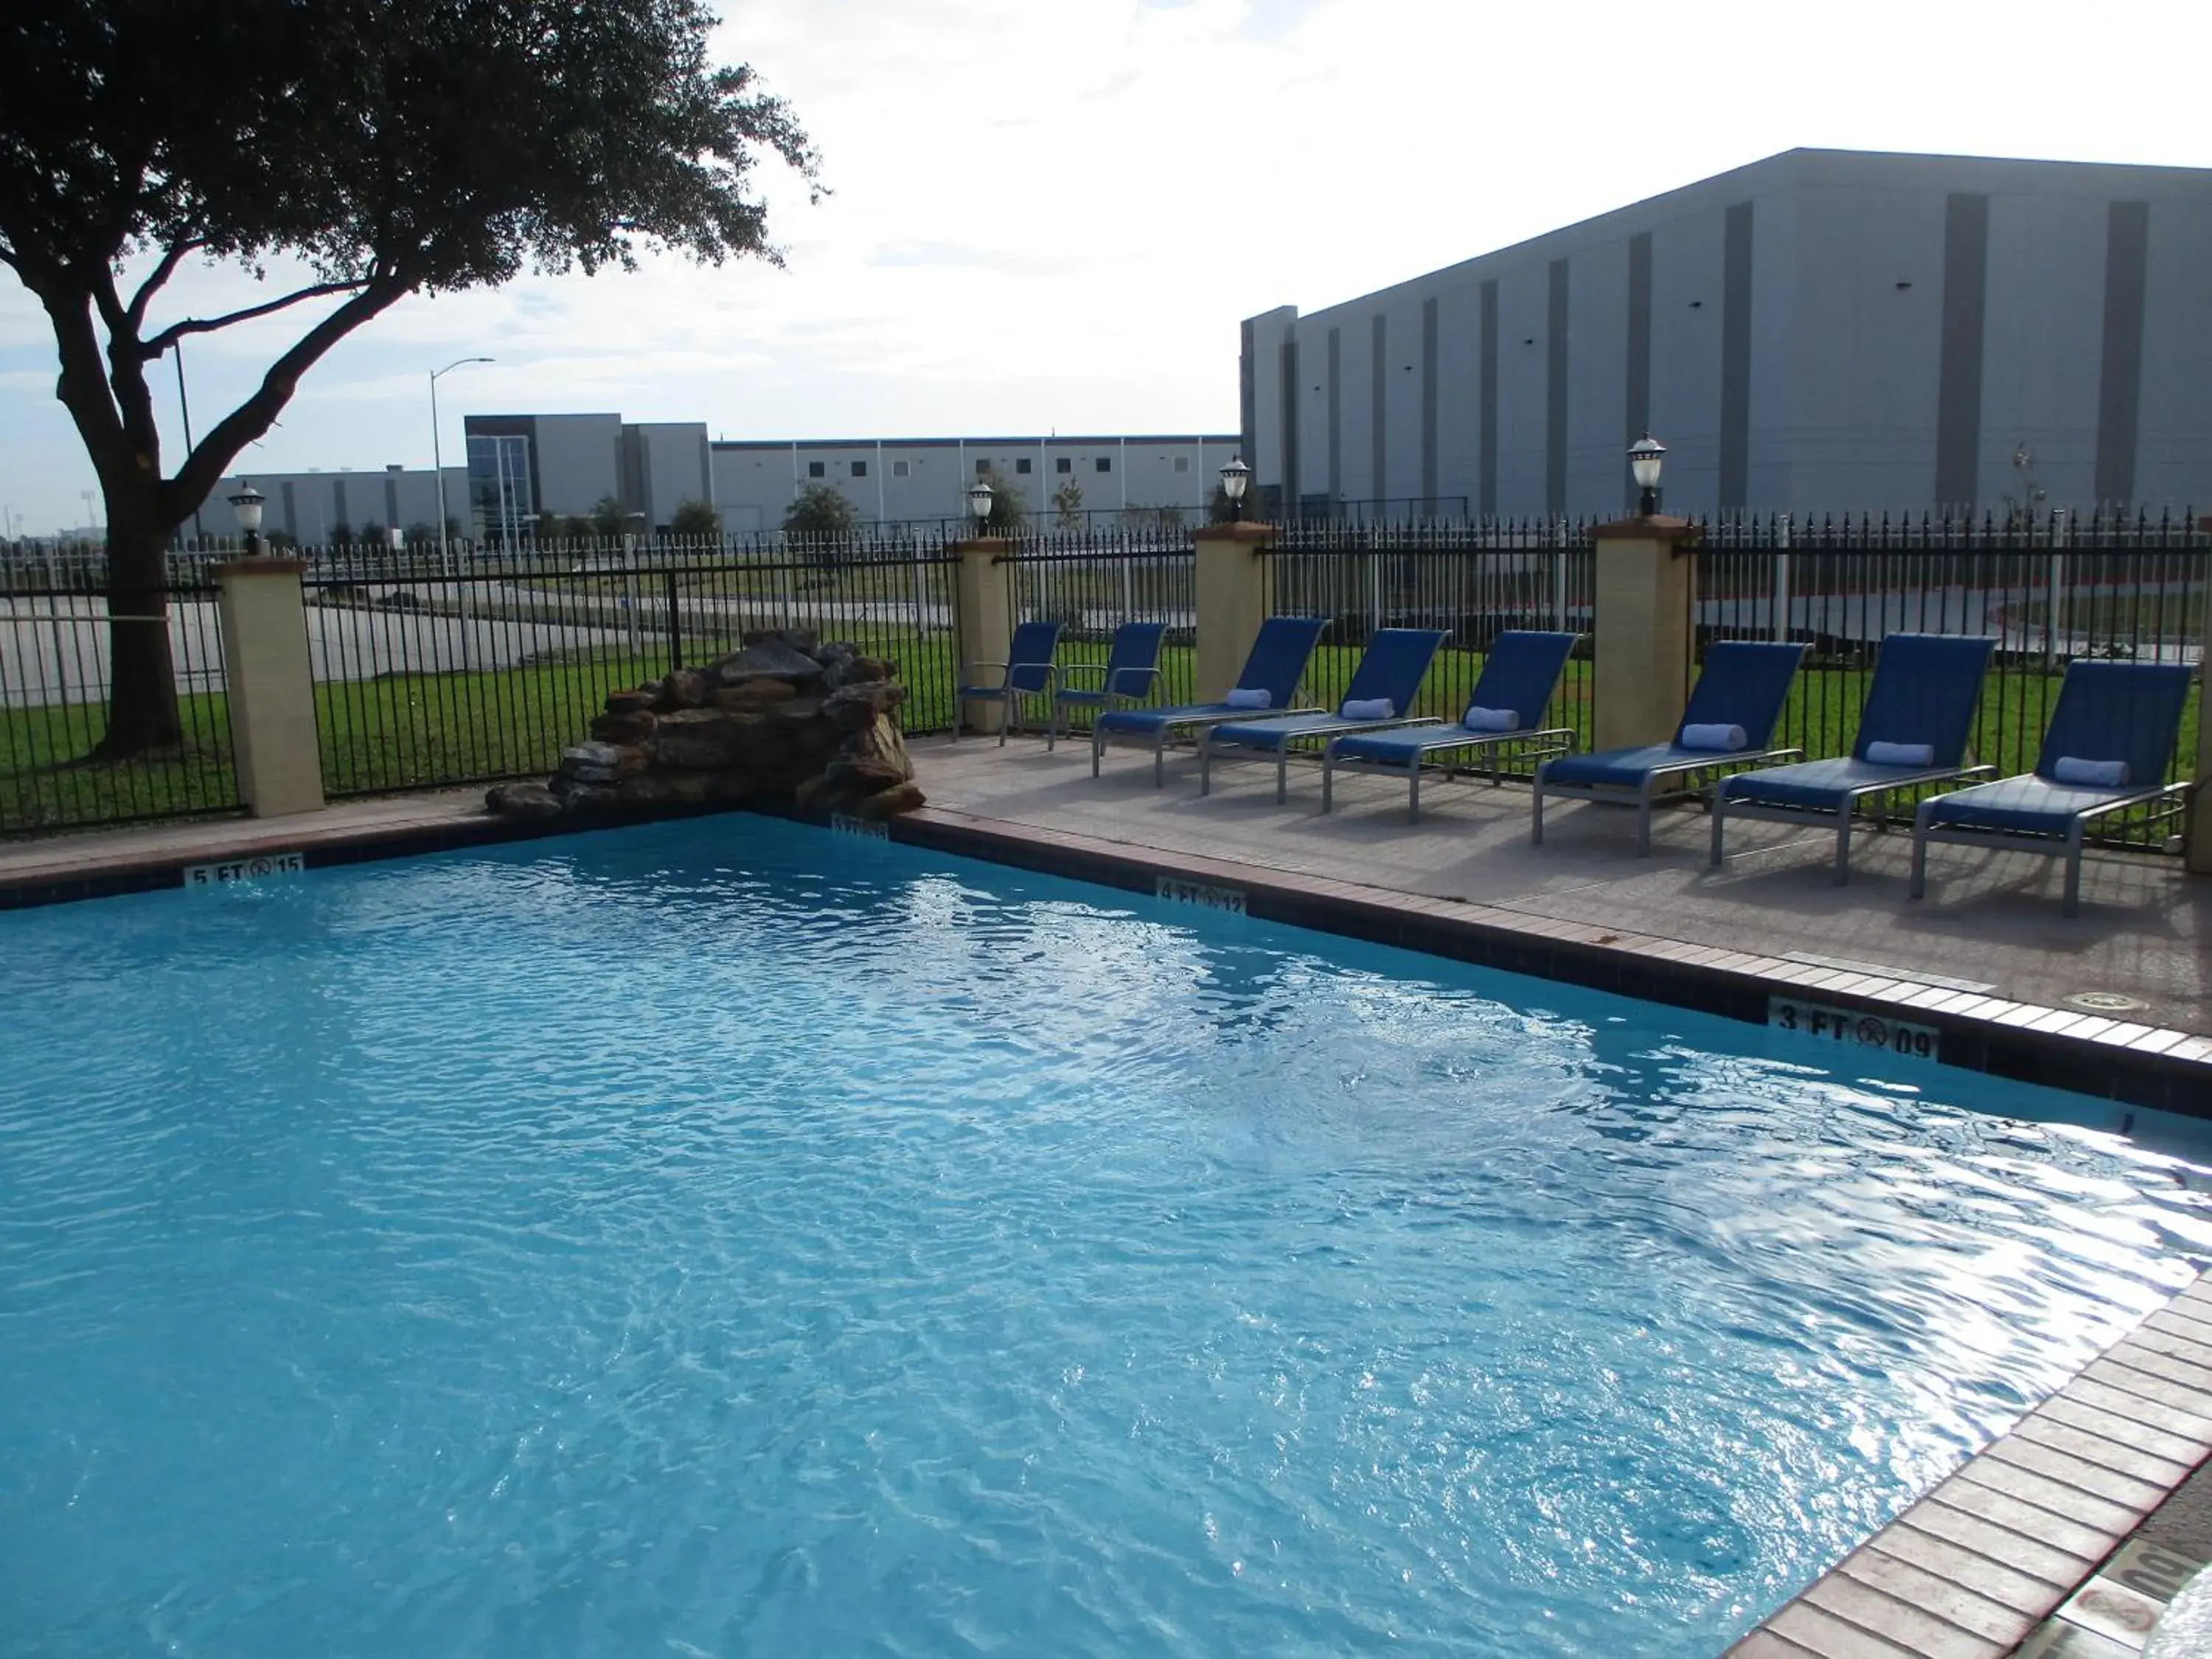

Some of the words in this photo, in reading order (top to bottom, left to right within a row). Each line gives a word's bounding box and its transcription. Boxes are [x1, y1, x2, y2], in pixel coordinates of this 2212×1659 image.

[193, 868, 207, 884] 5
[218, 863, 244, 881] FT
[277, 857, 299, 873] 15
[1162, 881, 1172, 900] 4
[1779, 1005, 1797, 1030] 3
[1811, 1009, 1849, 1041] FT
[1895, 1027, 1932, 1060] 09
